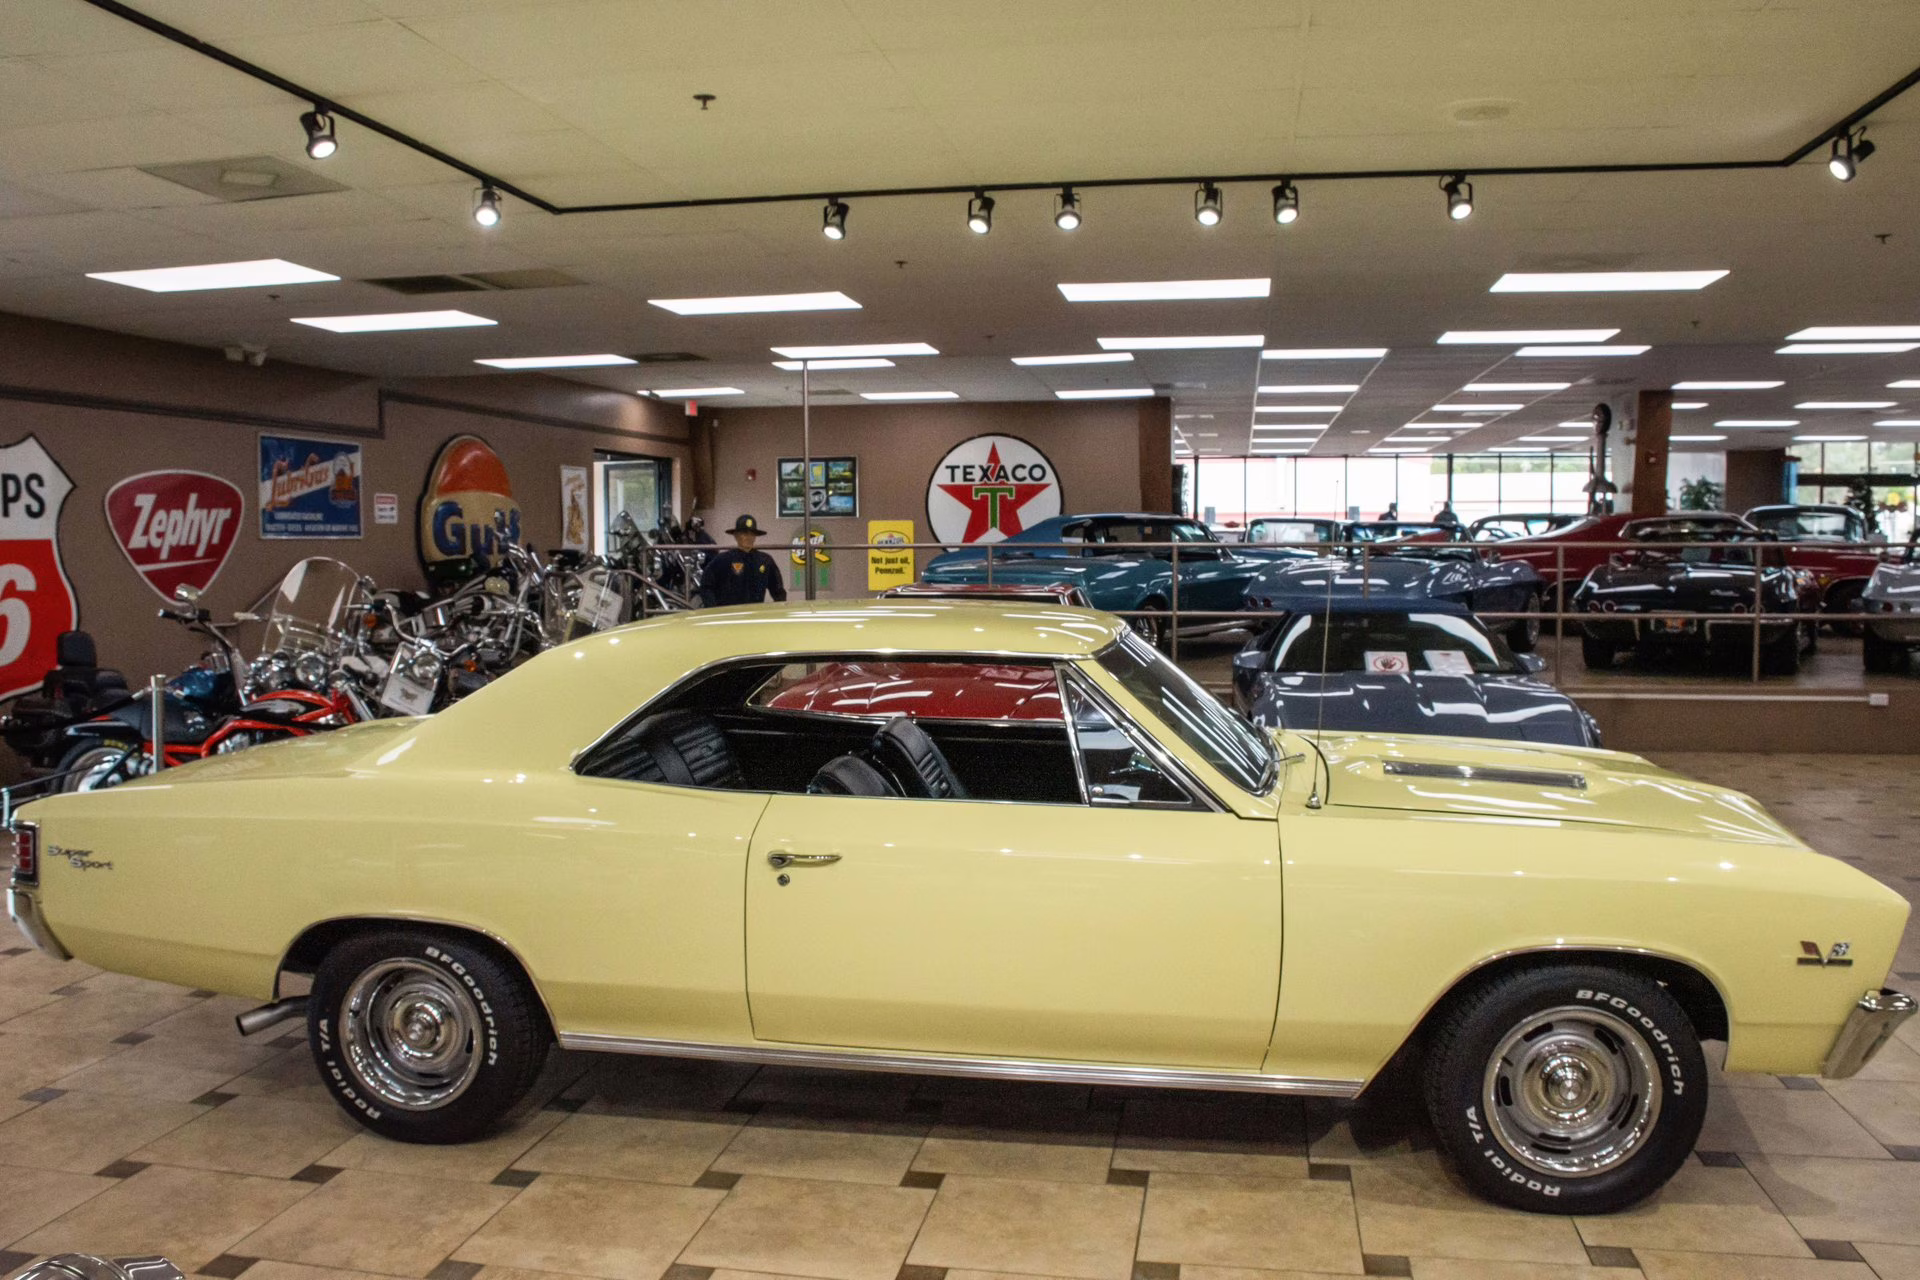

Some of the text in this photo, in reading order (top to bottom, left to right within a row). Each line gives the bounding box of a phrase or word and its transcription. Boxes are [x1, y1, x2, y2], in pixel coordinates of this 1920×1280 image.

[945, 464, 1046, 483] TEXACO
[127, 493, 232, 560] Zephyr
[47, 845, 93, 860] Super
[70, 857, 113, 872] Sport
[425, 946, 499, 1066] BFGoodrich
[1576, 989, 1685, 1096] BFGoodrich
[319, 1018, 382, 1120] Radial T/A
[1465, 1105, 1561, 1197] Radial T/A
